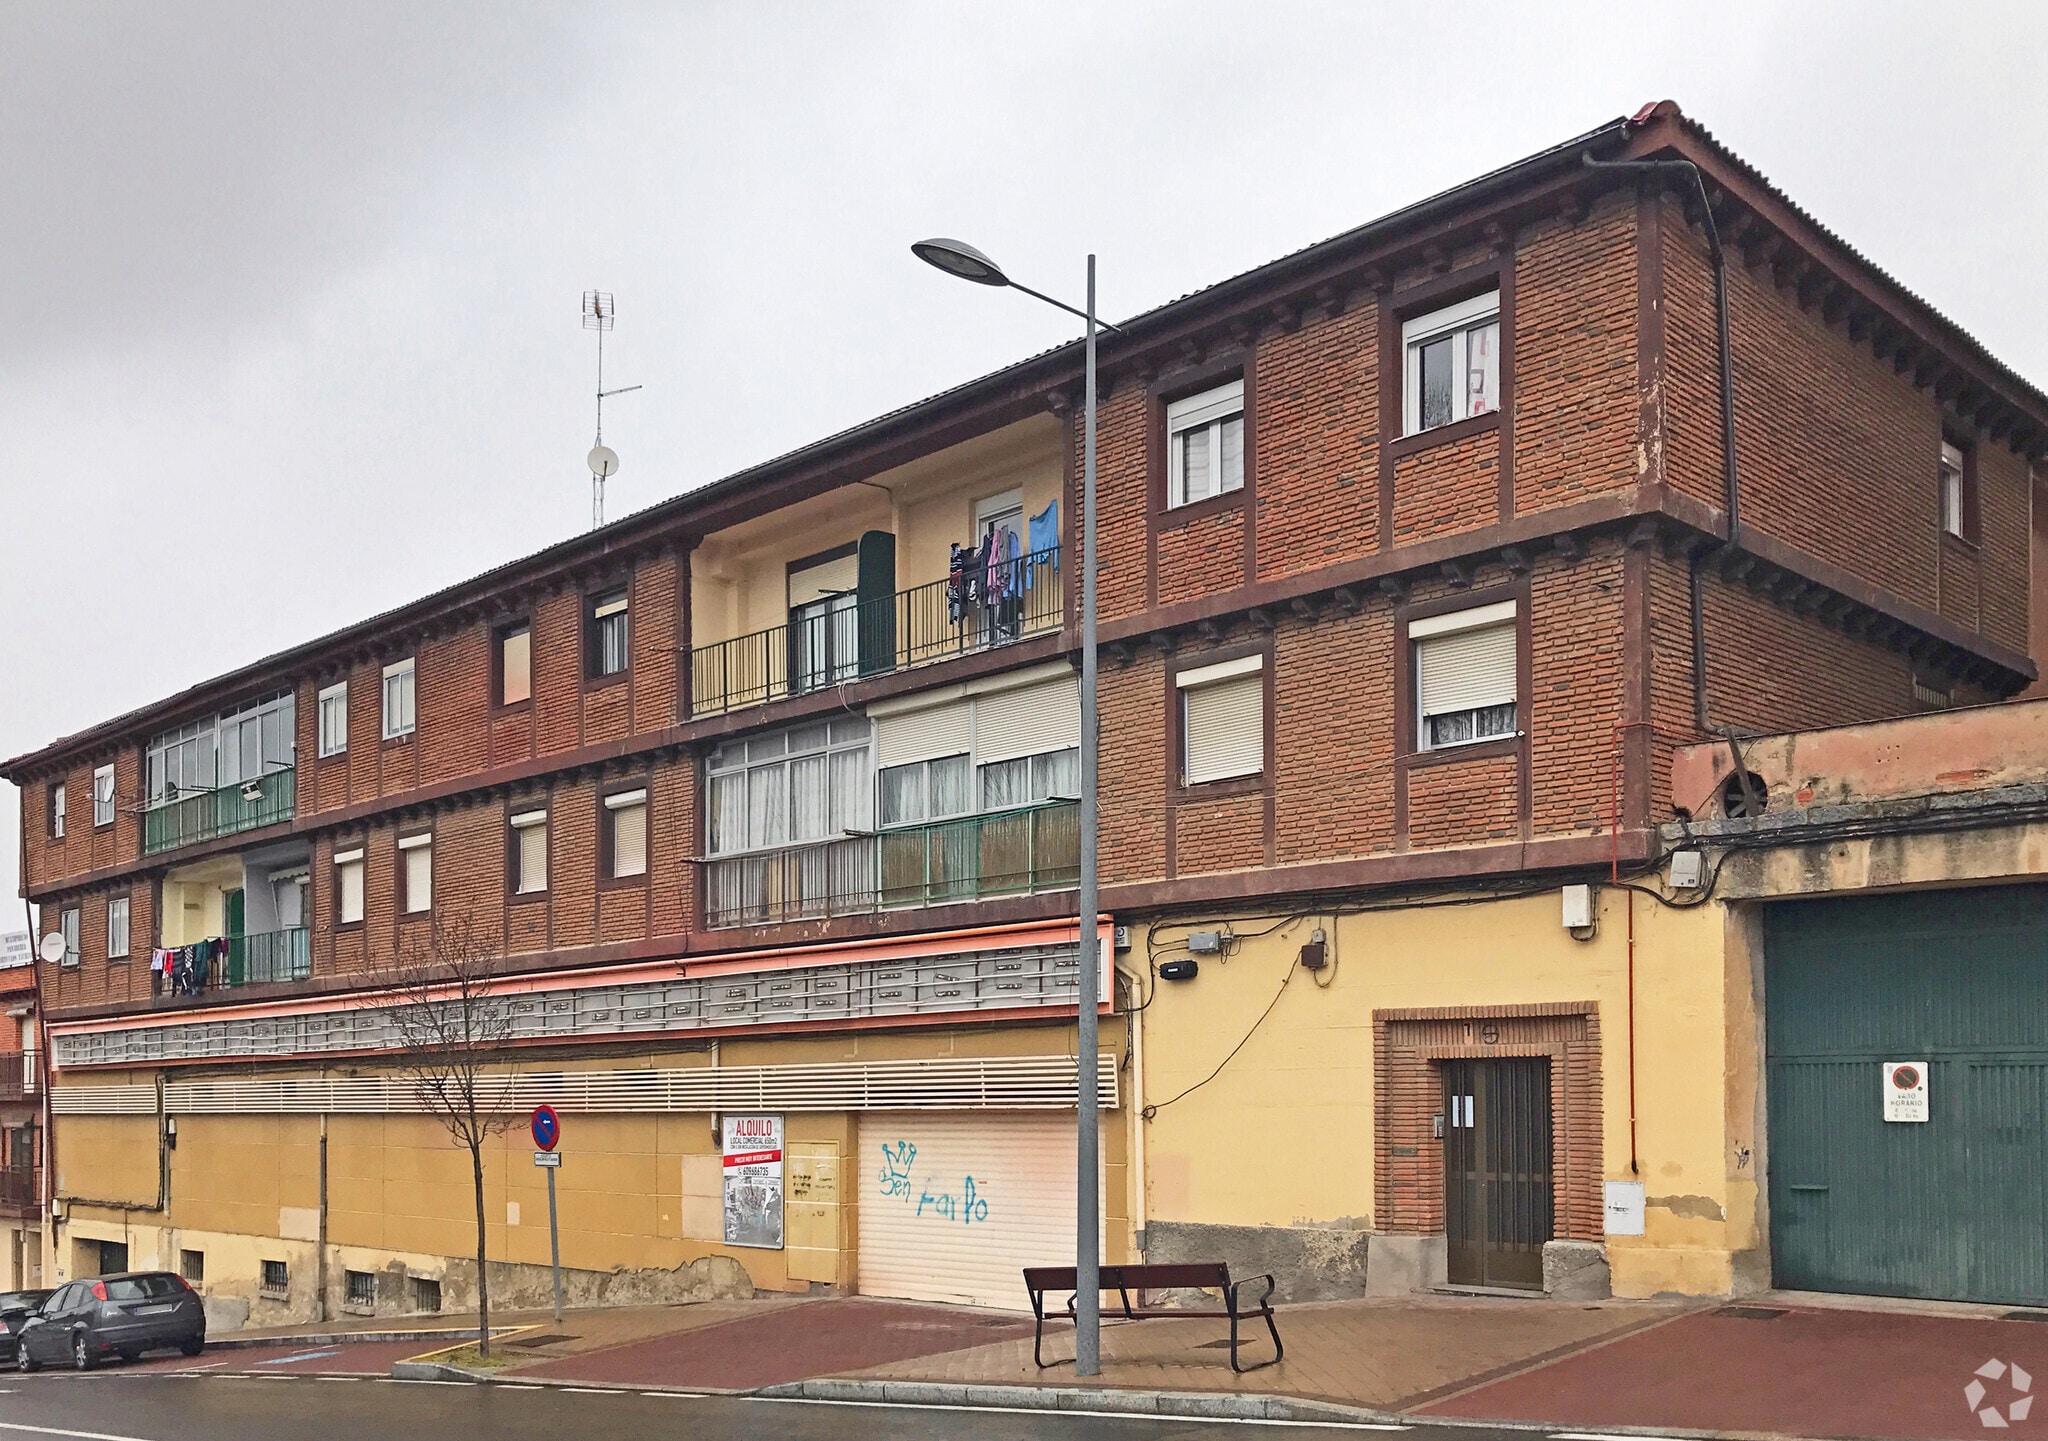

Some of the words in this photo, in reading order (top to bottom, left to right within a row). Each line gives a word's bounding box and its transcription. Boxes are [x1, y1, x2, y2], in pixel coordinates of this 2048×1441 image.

[736, 1120, 772, 1136] ALQUILO
[730, 1137, 742, 1145] LOCAL
[743, 1137, 764, 1145] COMERCIAL
